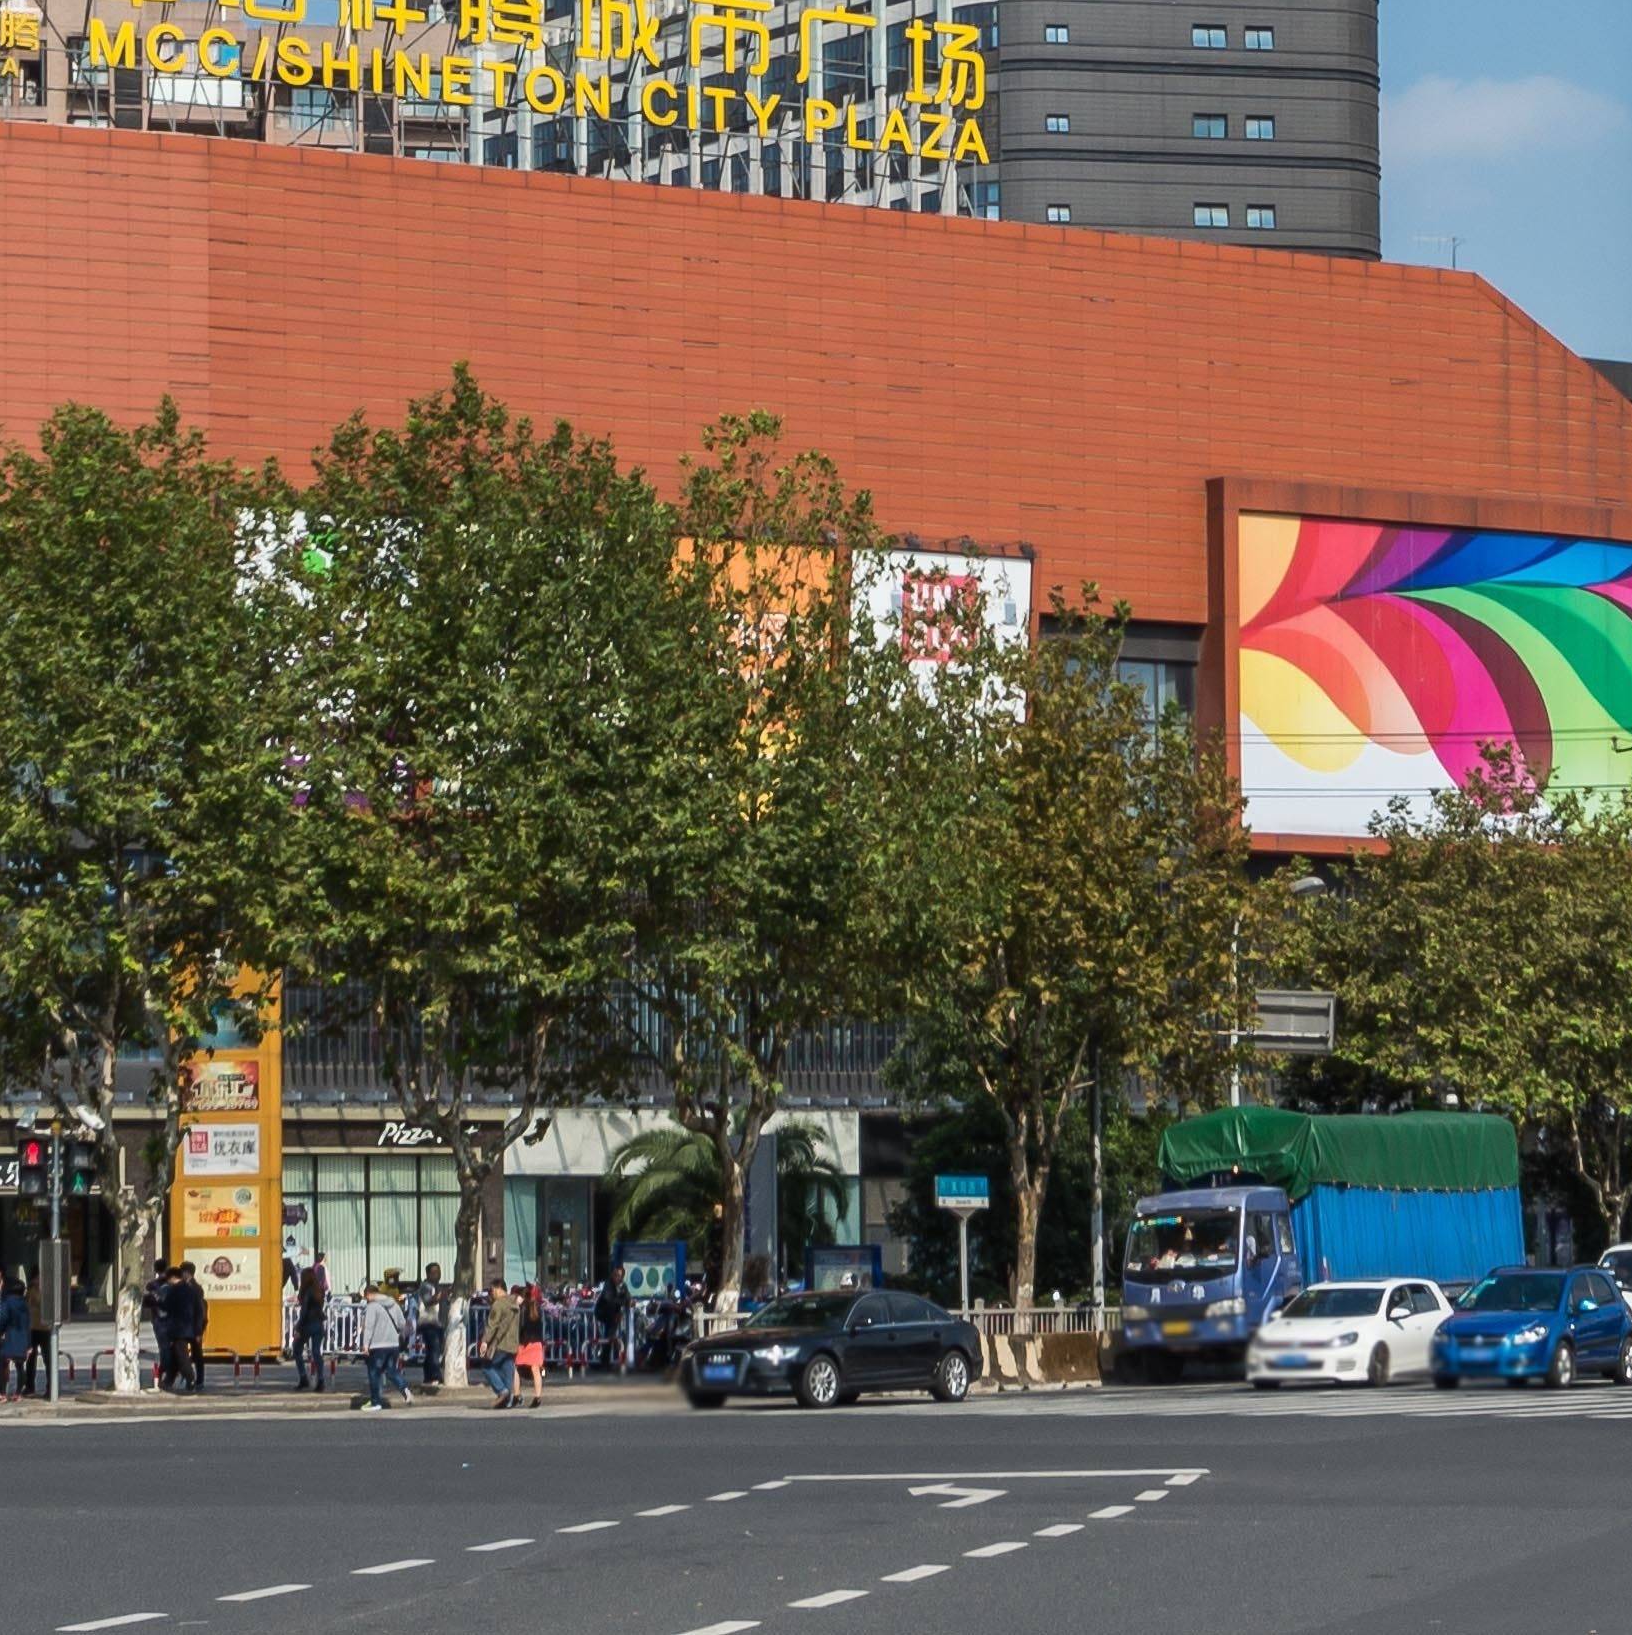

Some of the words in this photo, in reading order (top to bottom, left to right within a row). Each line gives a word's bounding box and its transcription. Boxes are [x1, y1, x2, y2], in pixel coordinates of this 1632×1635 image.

[89, 18, 611, 120] MCC/SHINETON
[641, 79, 781, 138] CITY
[805, 98, 990, 165] PLAZA
[377, 1122, 435, 1146] Pizza
